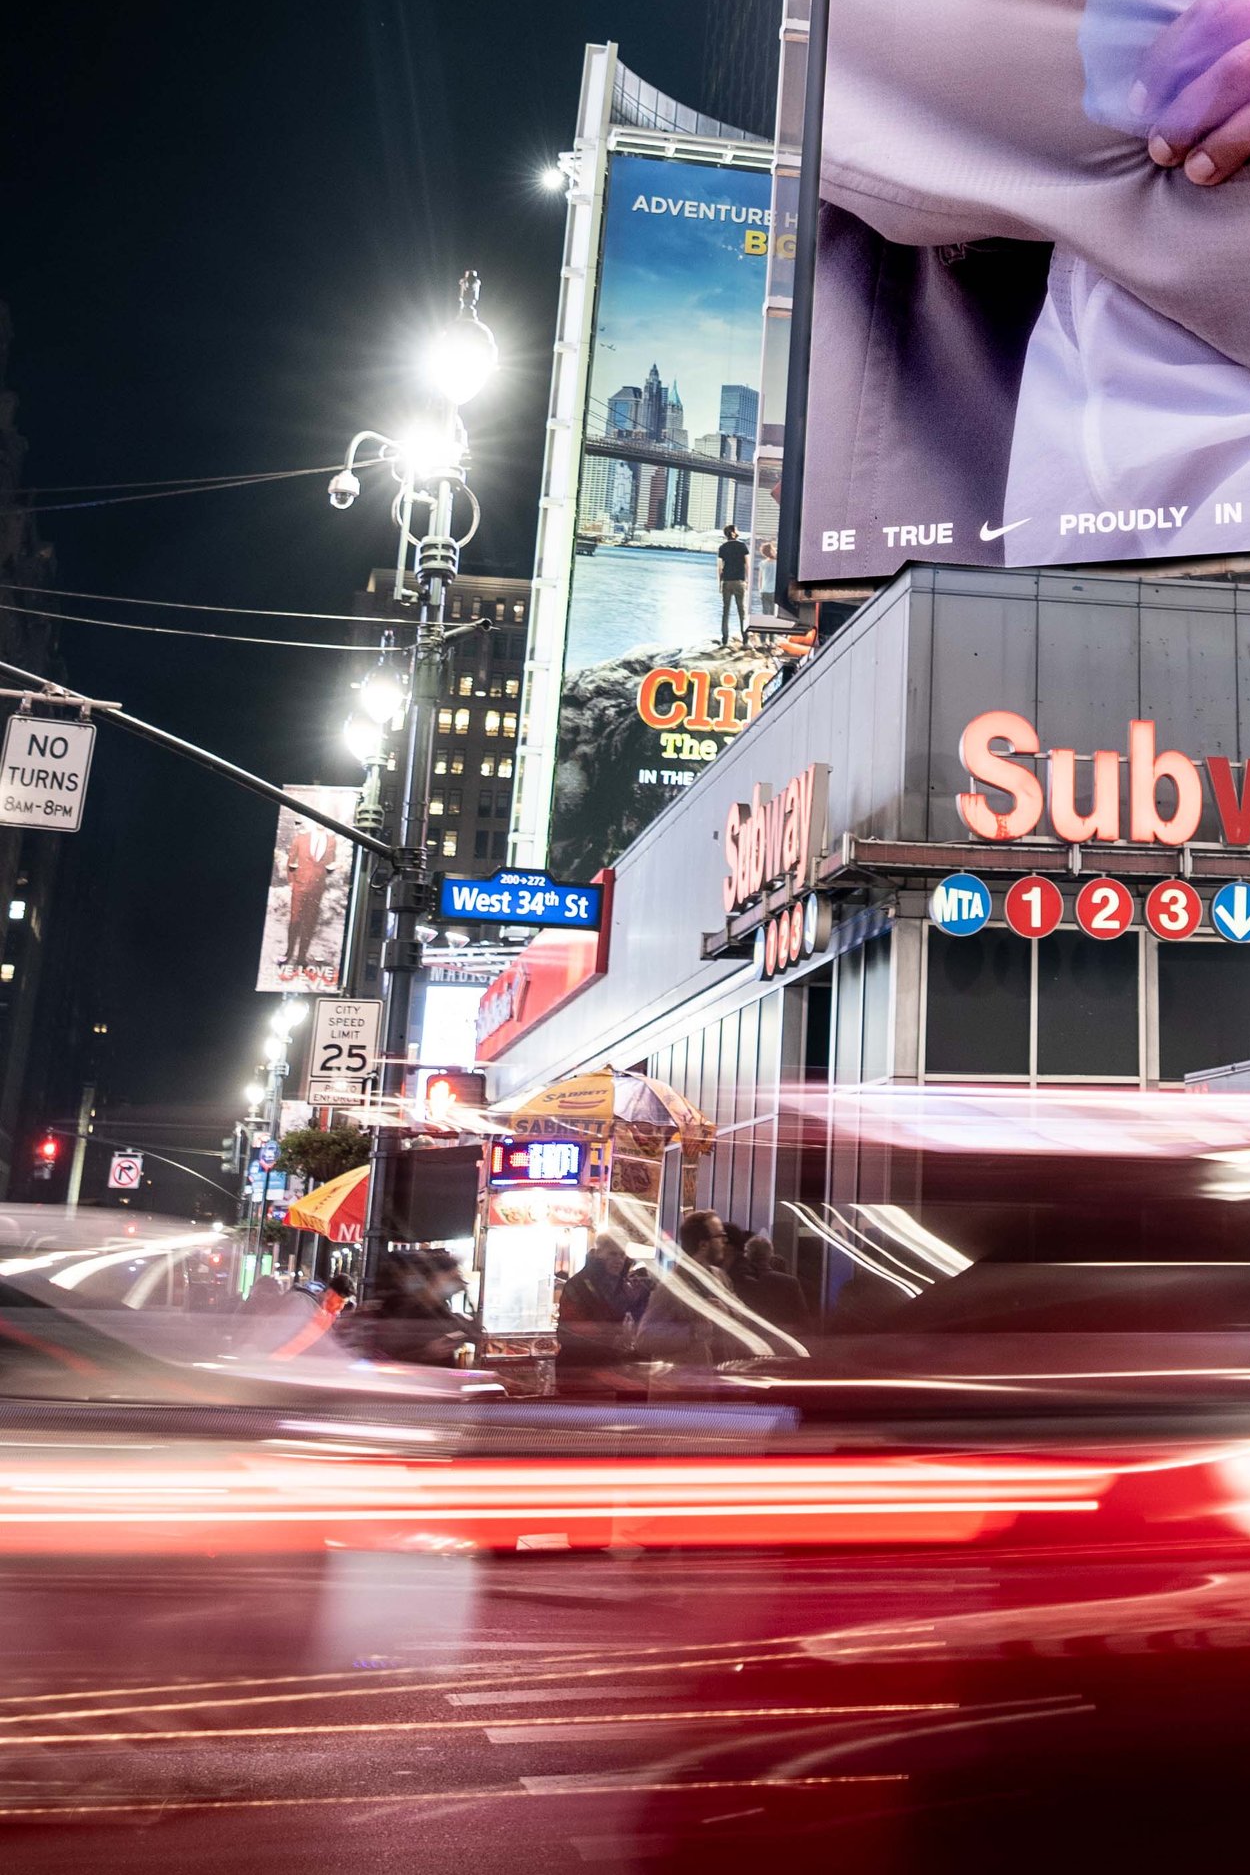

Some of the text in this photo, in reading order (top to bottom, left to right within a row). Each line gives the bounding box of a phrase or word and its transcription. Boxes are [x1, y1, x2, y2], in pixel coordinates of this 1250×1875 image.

[632, 194, 777, 227] ADVENTURE
[744, 230, 797, 260] BG
[821, 529, 856, 552] BE
[882, 522, 954, 548] TRUE
[1059, 505, 1189, 536] PROUDLY
[1214, 502, 1242, 525] IN
[637, 667, 778, 733] Clif
[27, 733, 69, 759] NO
[660, 732, 718, 761] The
[8, 766, 79, 792] TURNS
[639, 769, 657, 784] IN
[723, 763, 819, 913] Subway
[452, 886, 589, 919] West 34th St
[934, 885, 1189, 929] MTA 1 2 3
[328, 1018, 366, 1028] SPEED
[336, 1005, 362, 1015] CITY
[331, 1031, 361, 1040] LIMIT
[320, 1043, 367, 1073] 25
